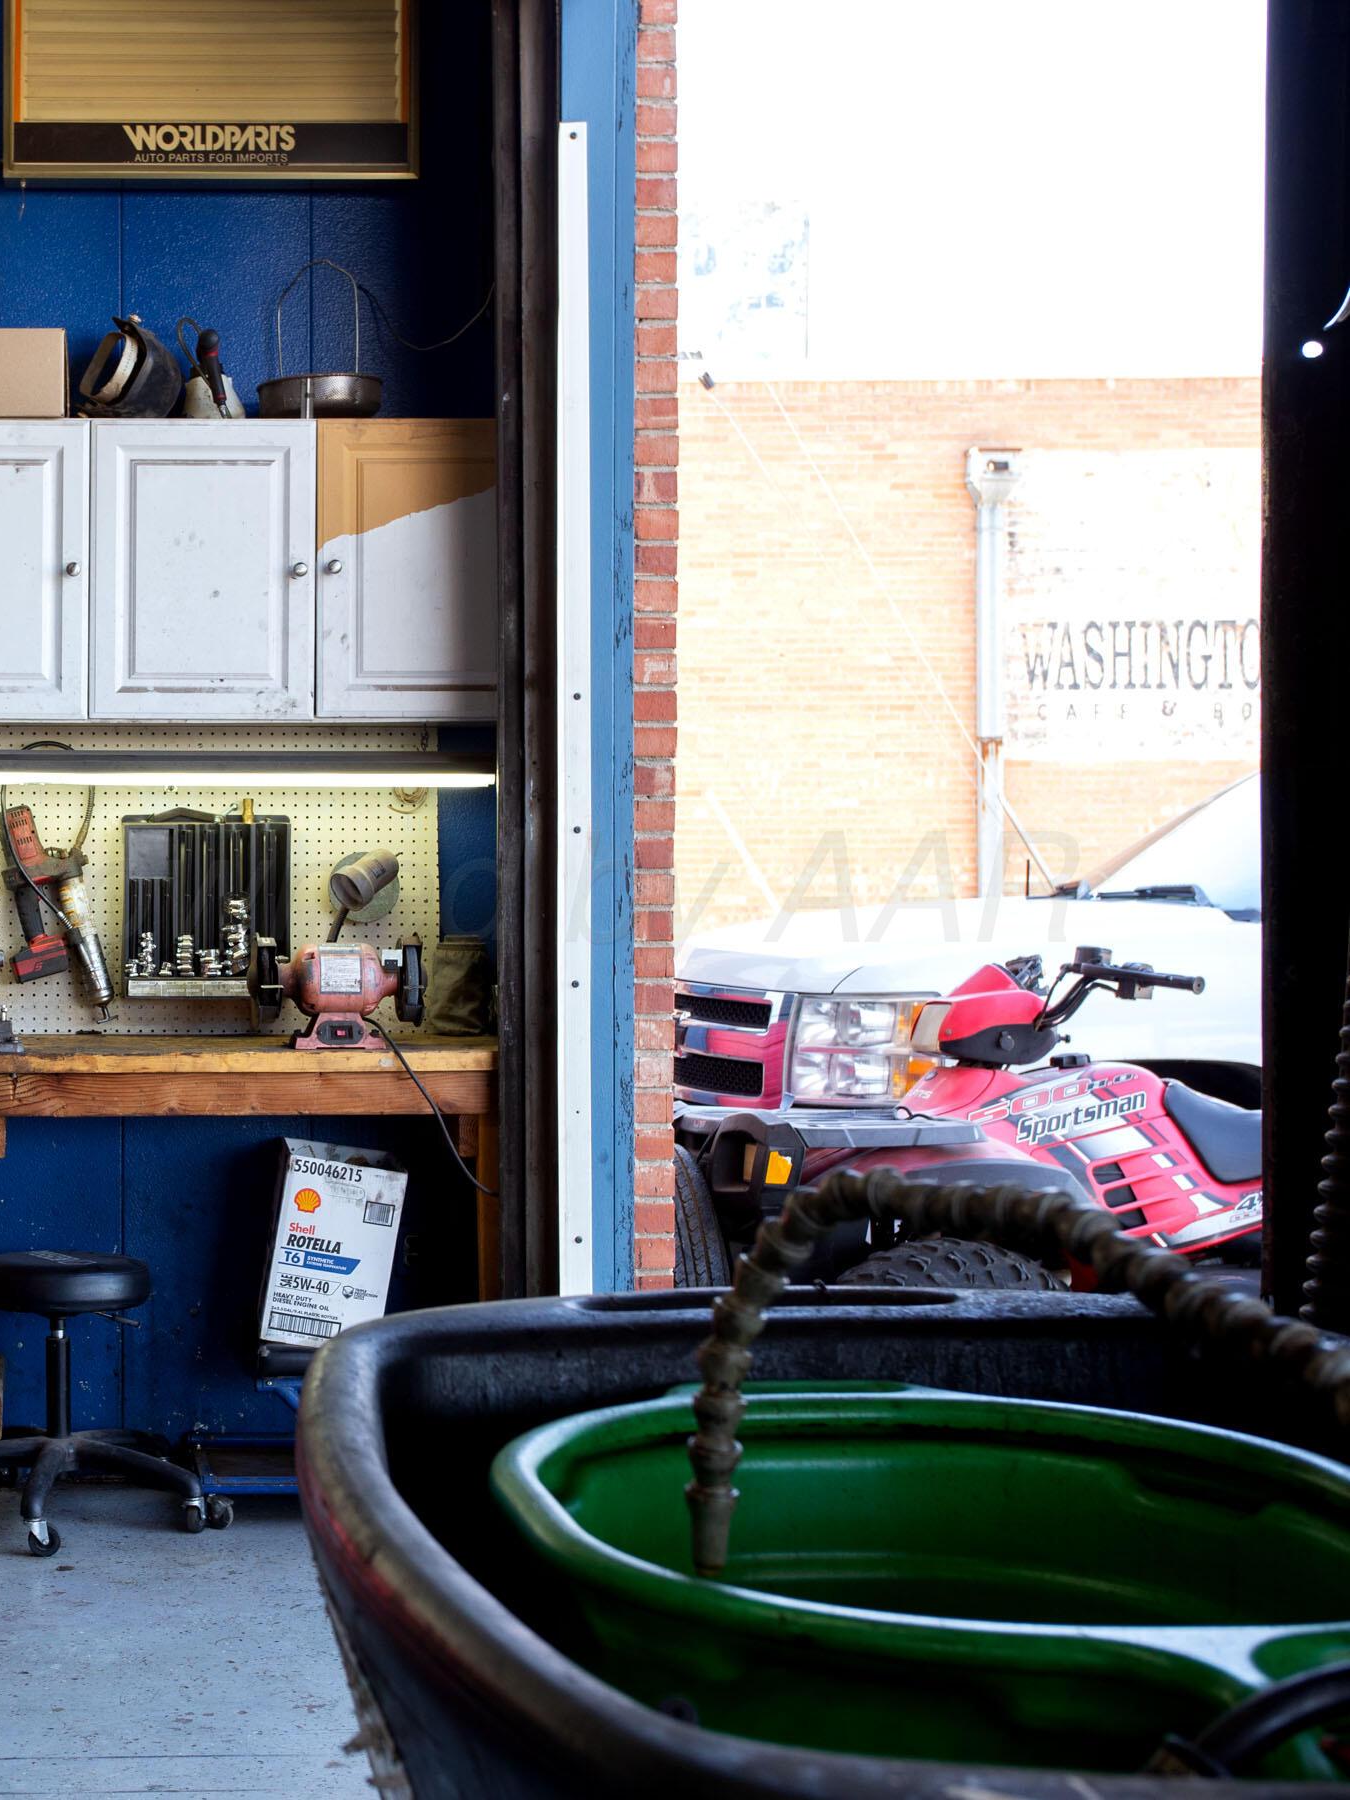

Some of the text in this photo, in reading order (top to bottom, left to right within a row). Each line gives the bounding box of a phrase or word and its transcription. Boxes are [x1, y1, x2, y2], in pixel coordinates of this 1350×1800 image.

[123, 125, 296, 152] WORLDPARTS
[134, 153, 288, 163] AUTO PARTS FOR IMPORTS
[1037, 703, 1129, 720] CAFE
[1161, 700, 1177, 717] &
[967, 1078, 1091, 1125] 500
[1016, 1091, 1147, 1145] Sportsman
[293, 1159, 363, 1183] 550046215
[289, 1222, 315, 1236] Shell
[286, 1233, 341, 1255] ROTELLA
[284, 1250, 300, 1265] T6
[279, 1274, 330, 1294] SAE 5W-40
[272, 1297, 292, 1305] DIESEL
[293, 1301, 318, 1310] ENGINE
[273, 1291, 294, 1300] HEAVY
